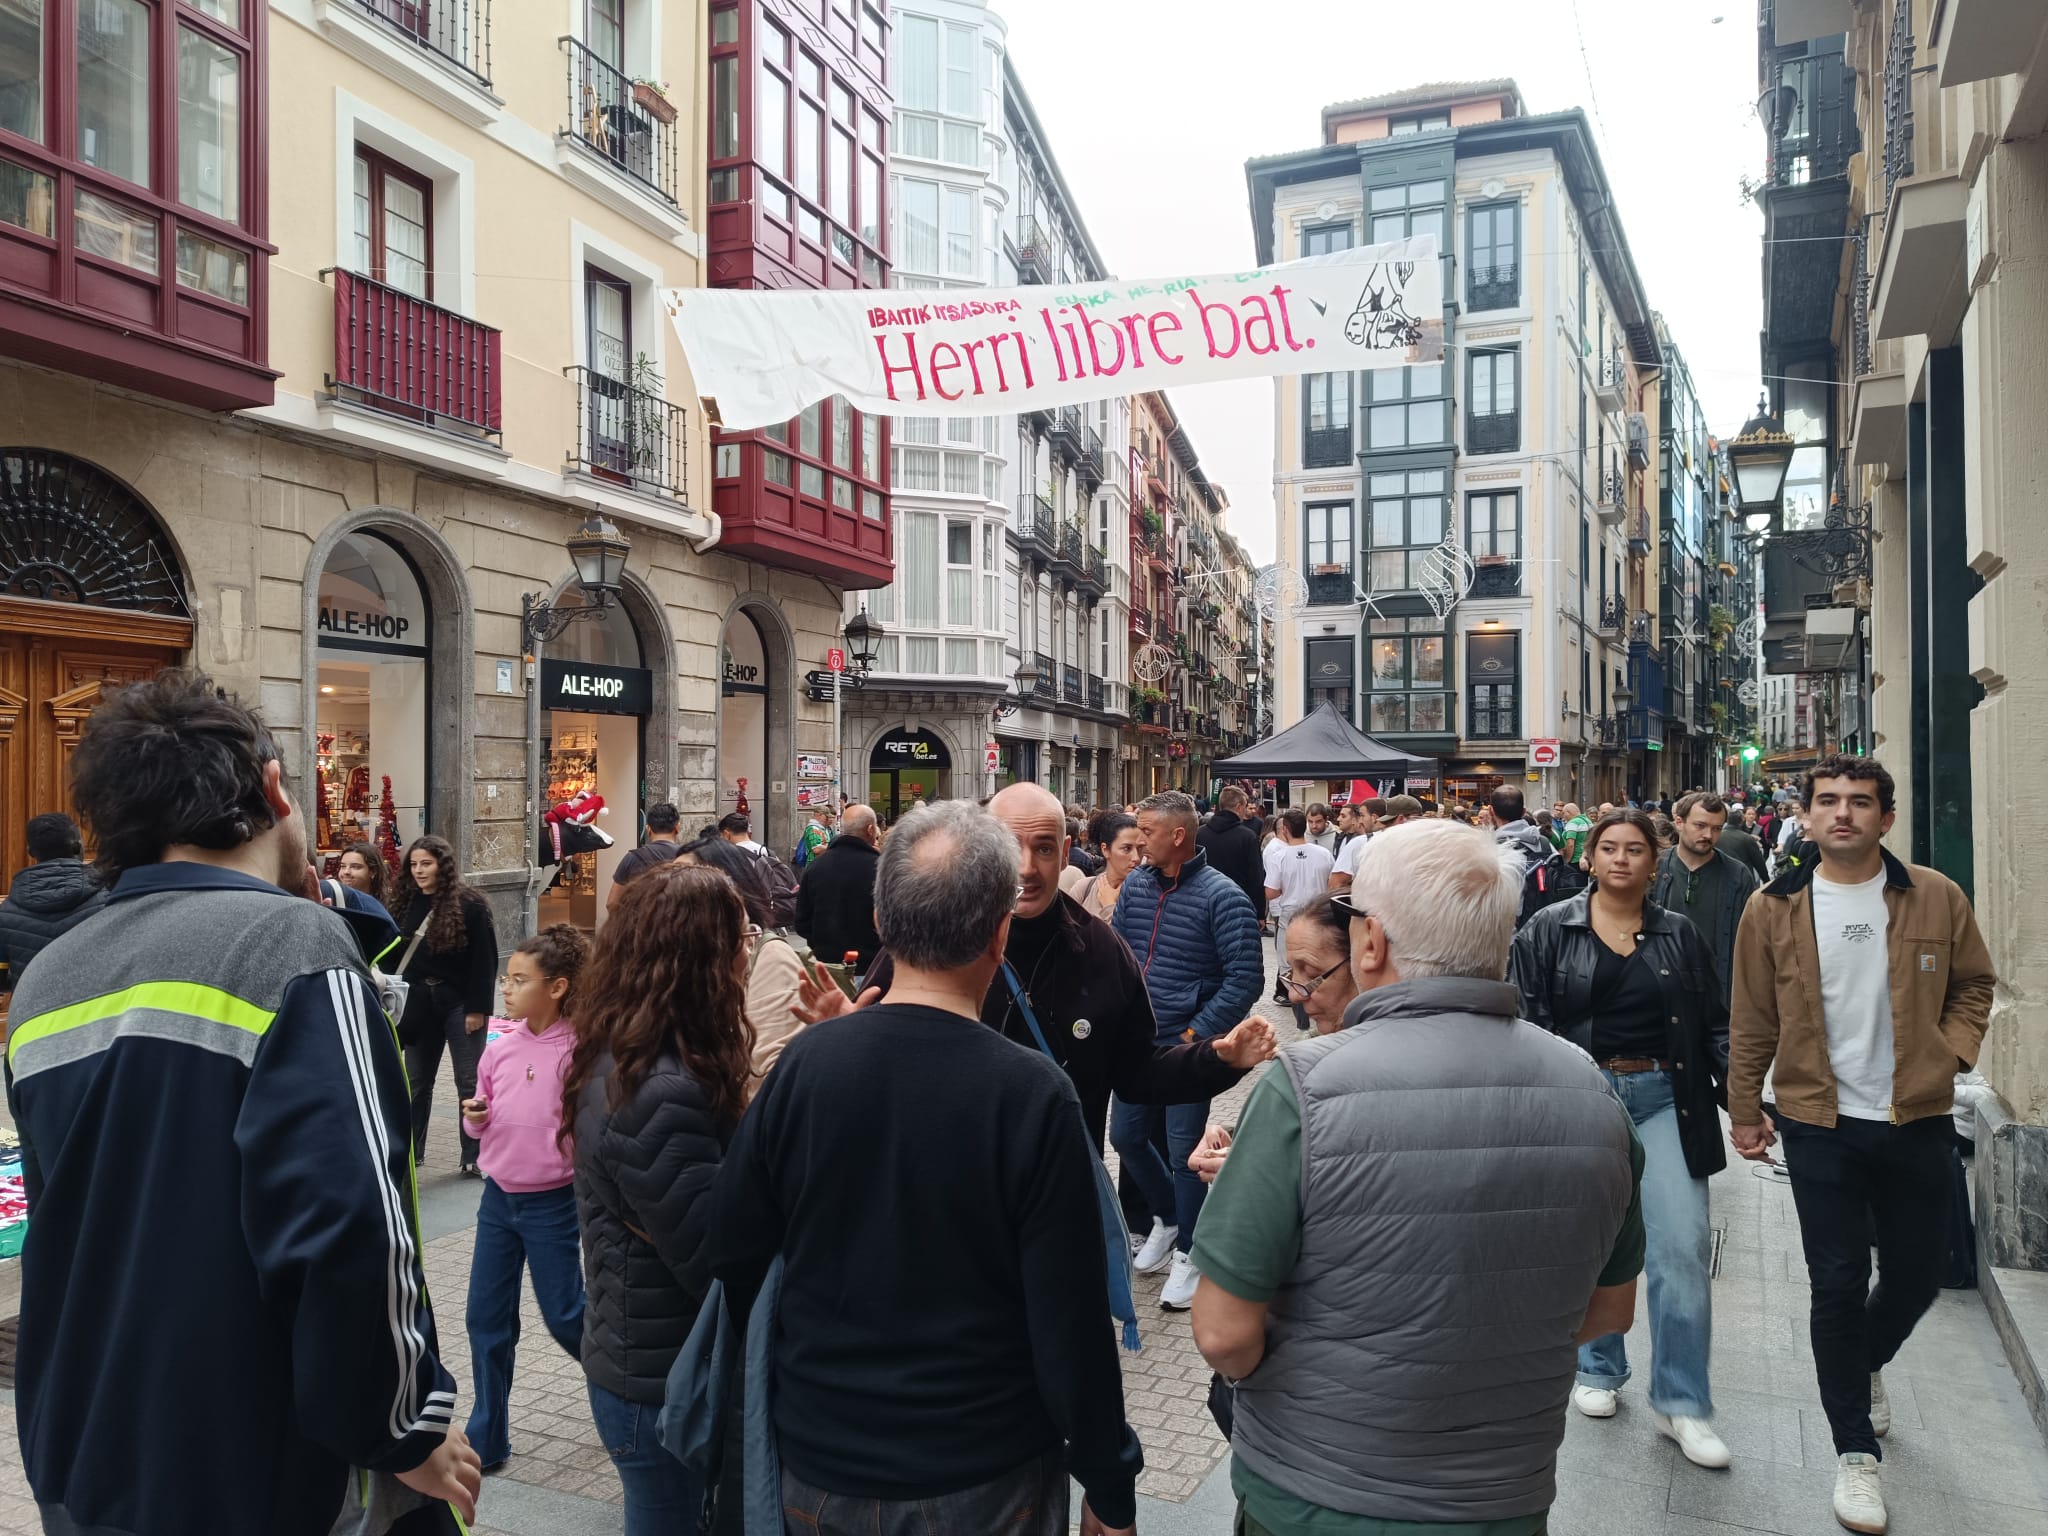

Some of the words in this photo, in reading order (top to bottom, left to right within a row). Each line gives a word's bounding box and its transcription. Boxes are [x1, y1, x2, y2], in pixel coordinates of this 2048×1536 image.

[867, 304, 931, 328] IBAITIK
[933, 299, 1022, 321] ITSASORA
[873, 314, 1034, 401] Herri
[1039, 302, 1184, 382] libre
[1186, 284, 1316, 359] bat.
[318, 607, 409, 639] ALE-HOP
[721, 662, 757, 681] LE-HOP
[561, 673, 623, 698] ALE-HOP
[885, 742, 928, 755] RETA
